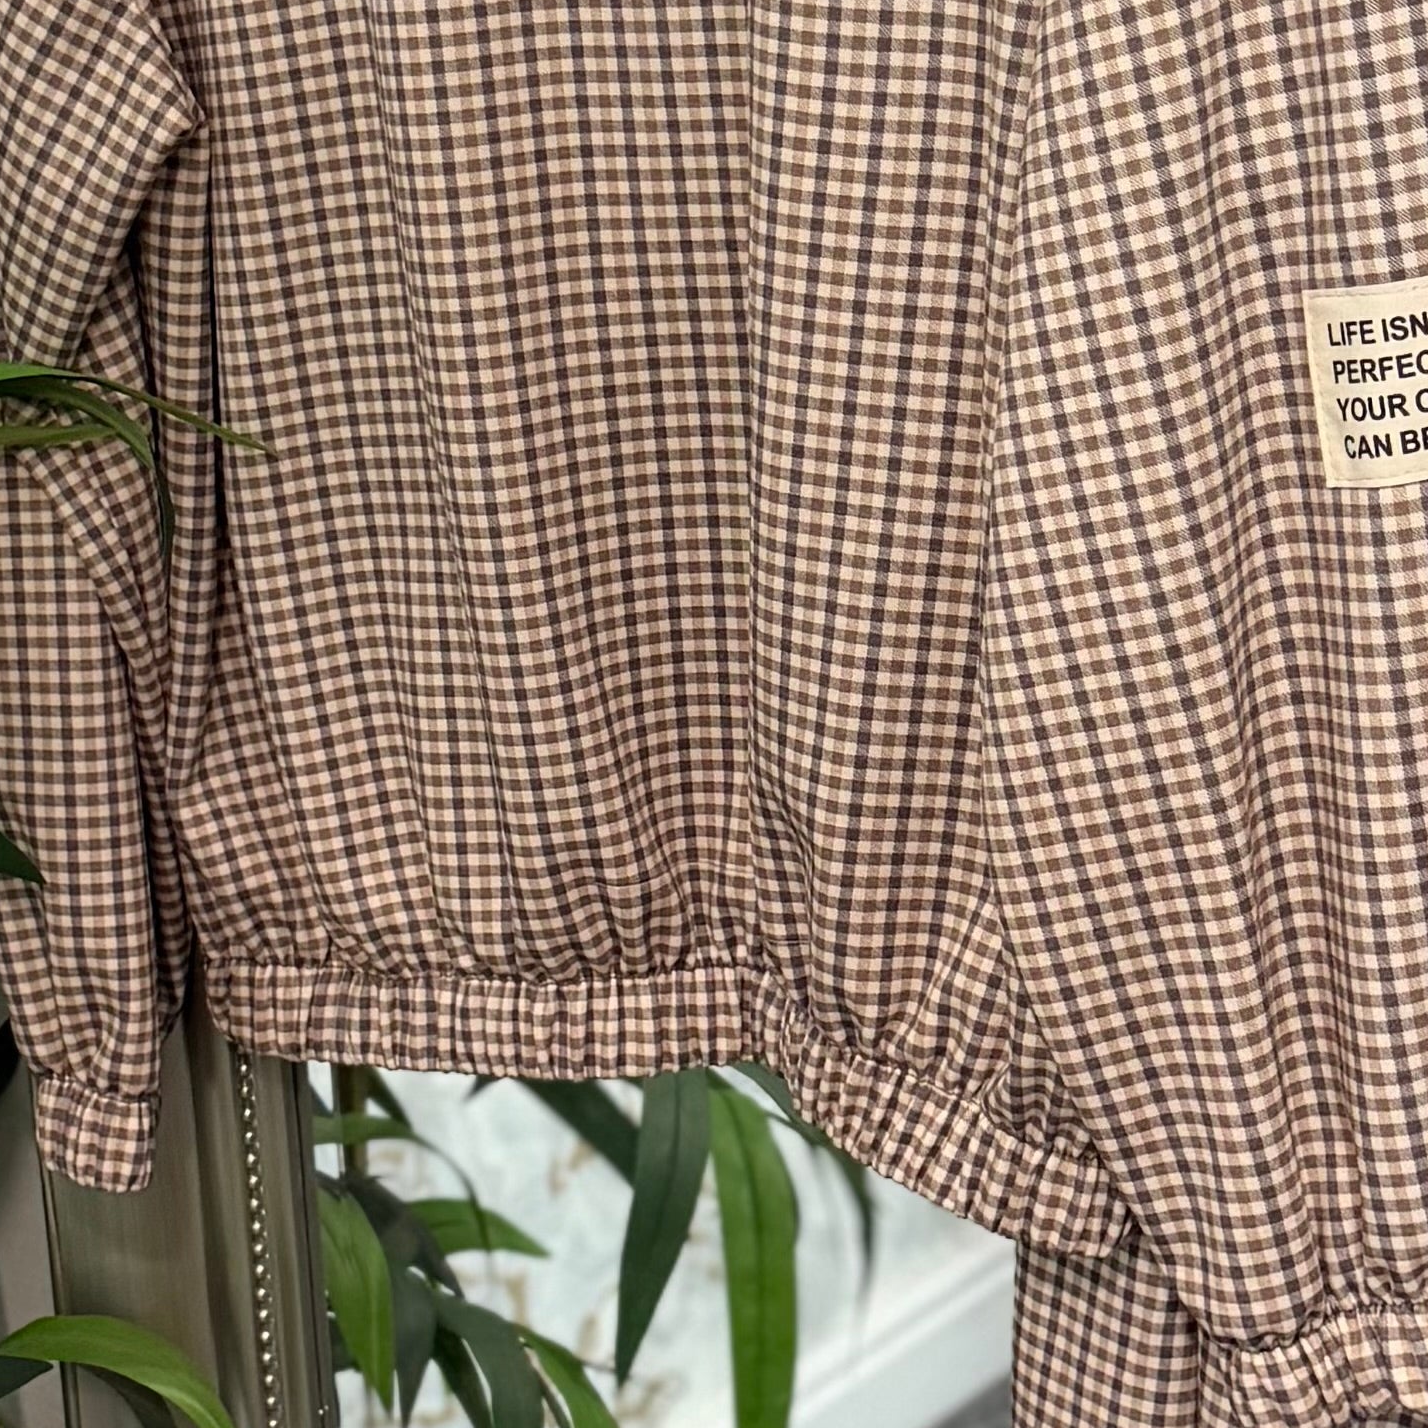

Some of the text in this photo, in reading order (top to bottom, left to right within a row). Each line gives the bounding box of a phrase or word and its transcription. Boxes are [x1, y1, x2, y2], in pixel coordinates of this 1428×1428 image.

[1327, 320, 1376, 346] LIFE
[1337, 393, 1410, 422] YOUR
[1344, 433, 1393, 459] CAN
